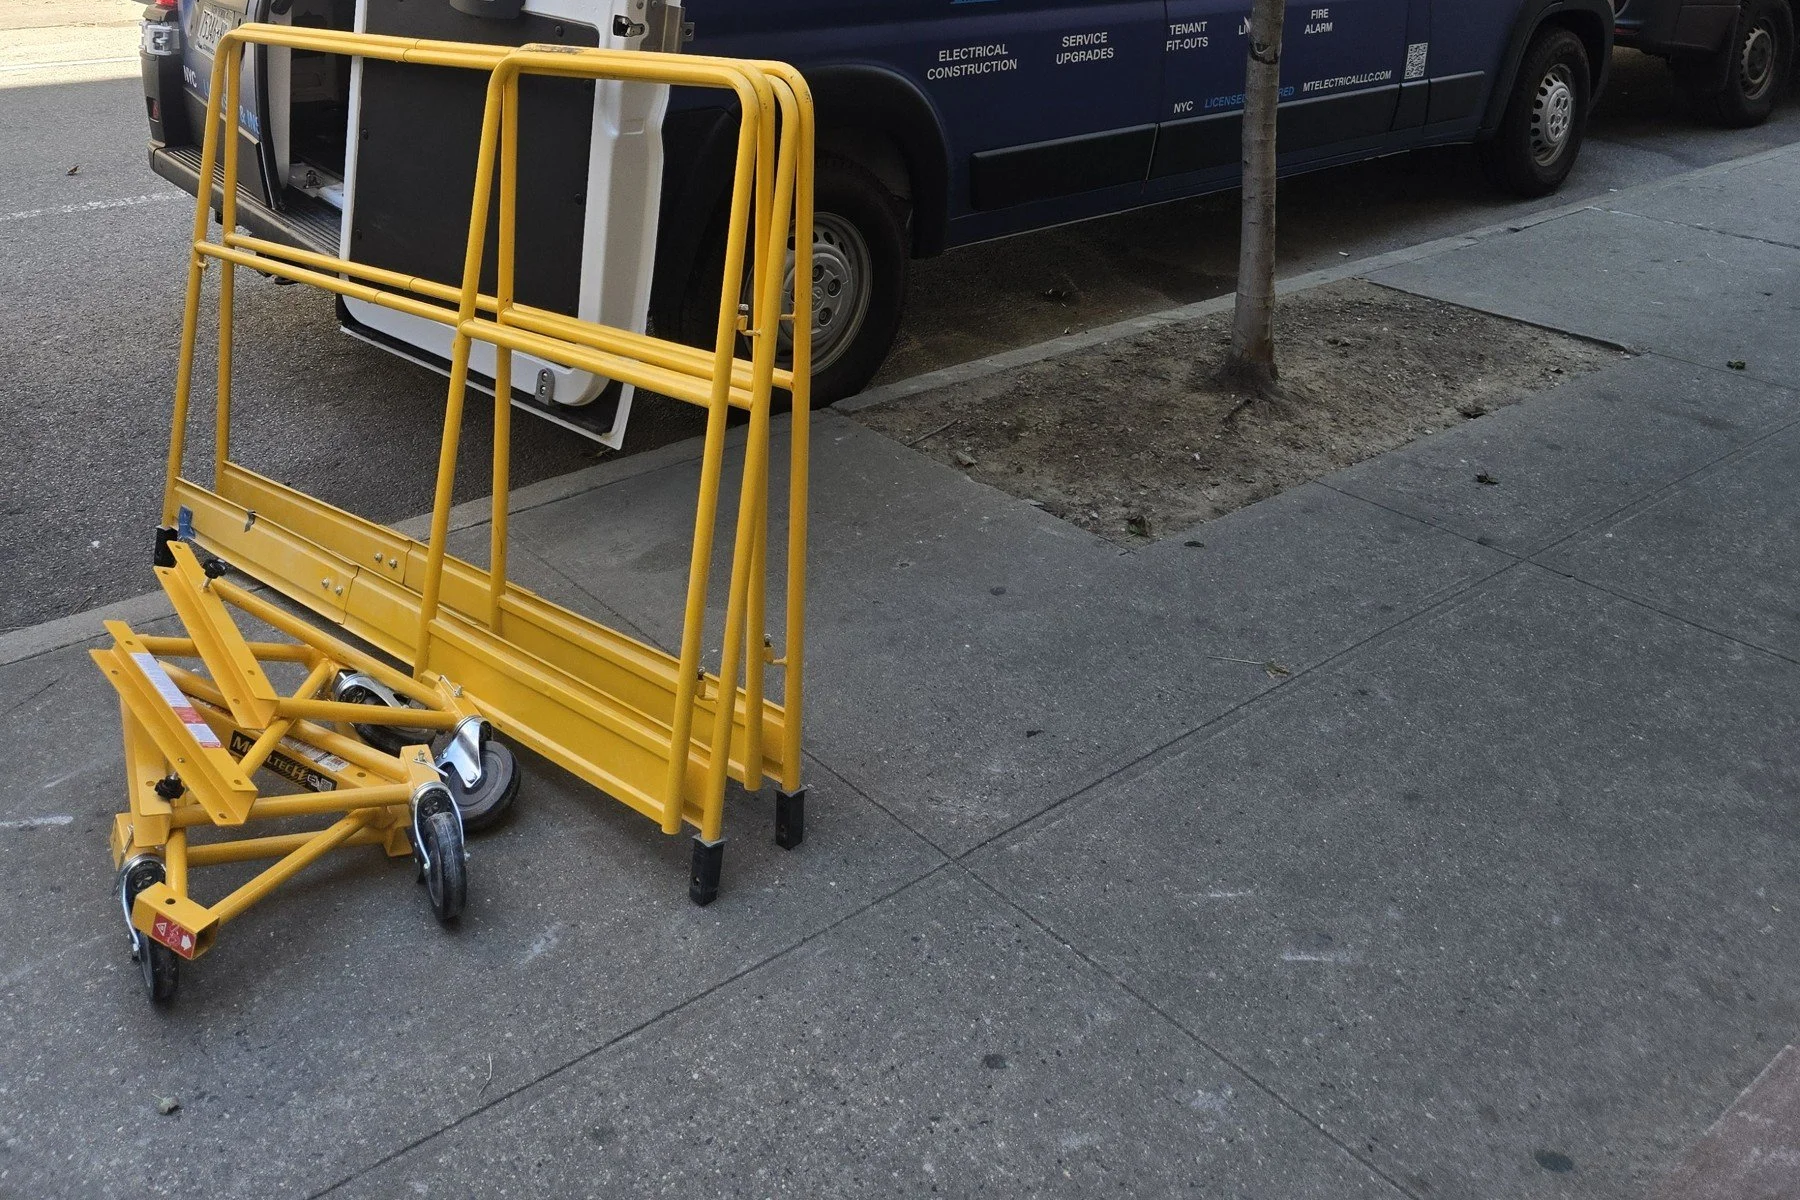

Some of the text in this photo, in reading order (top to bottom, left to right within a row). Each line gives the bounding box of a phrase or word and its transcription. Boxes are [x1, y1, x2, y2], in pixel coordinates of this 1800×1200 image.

[1311, 8, 1329, 20] FIRE
[1170, 21, 1208, 36] TENANT
[1304, 22, 1333, 35] ALARM
[1062, 31, 1108, 48] SERVICE
[1166, 37, 1209, 52] FIT-OUTS
[938, 43, 1009, 62] ELECTRICAL
[1056, 47, 1114, 65] UPGRADES
[183, 65, 198, 88] NYC
[927, 58, 1018, 81] CONSTRUCTION
[1173, 100, 1194, 114] NYC
[1303, 69, 1392, 93] MTELECTRICALLLC.COM
